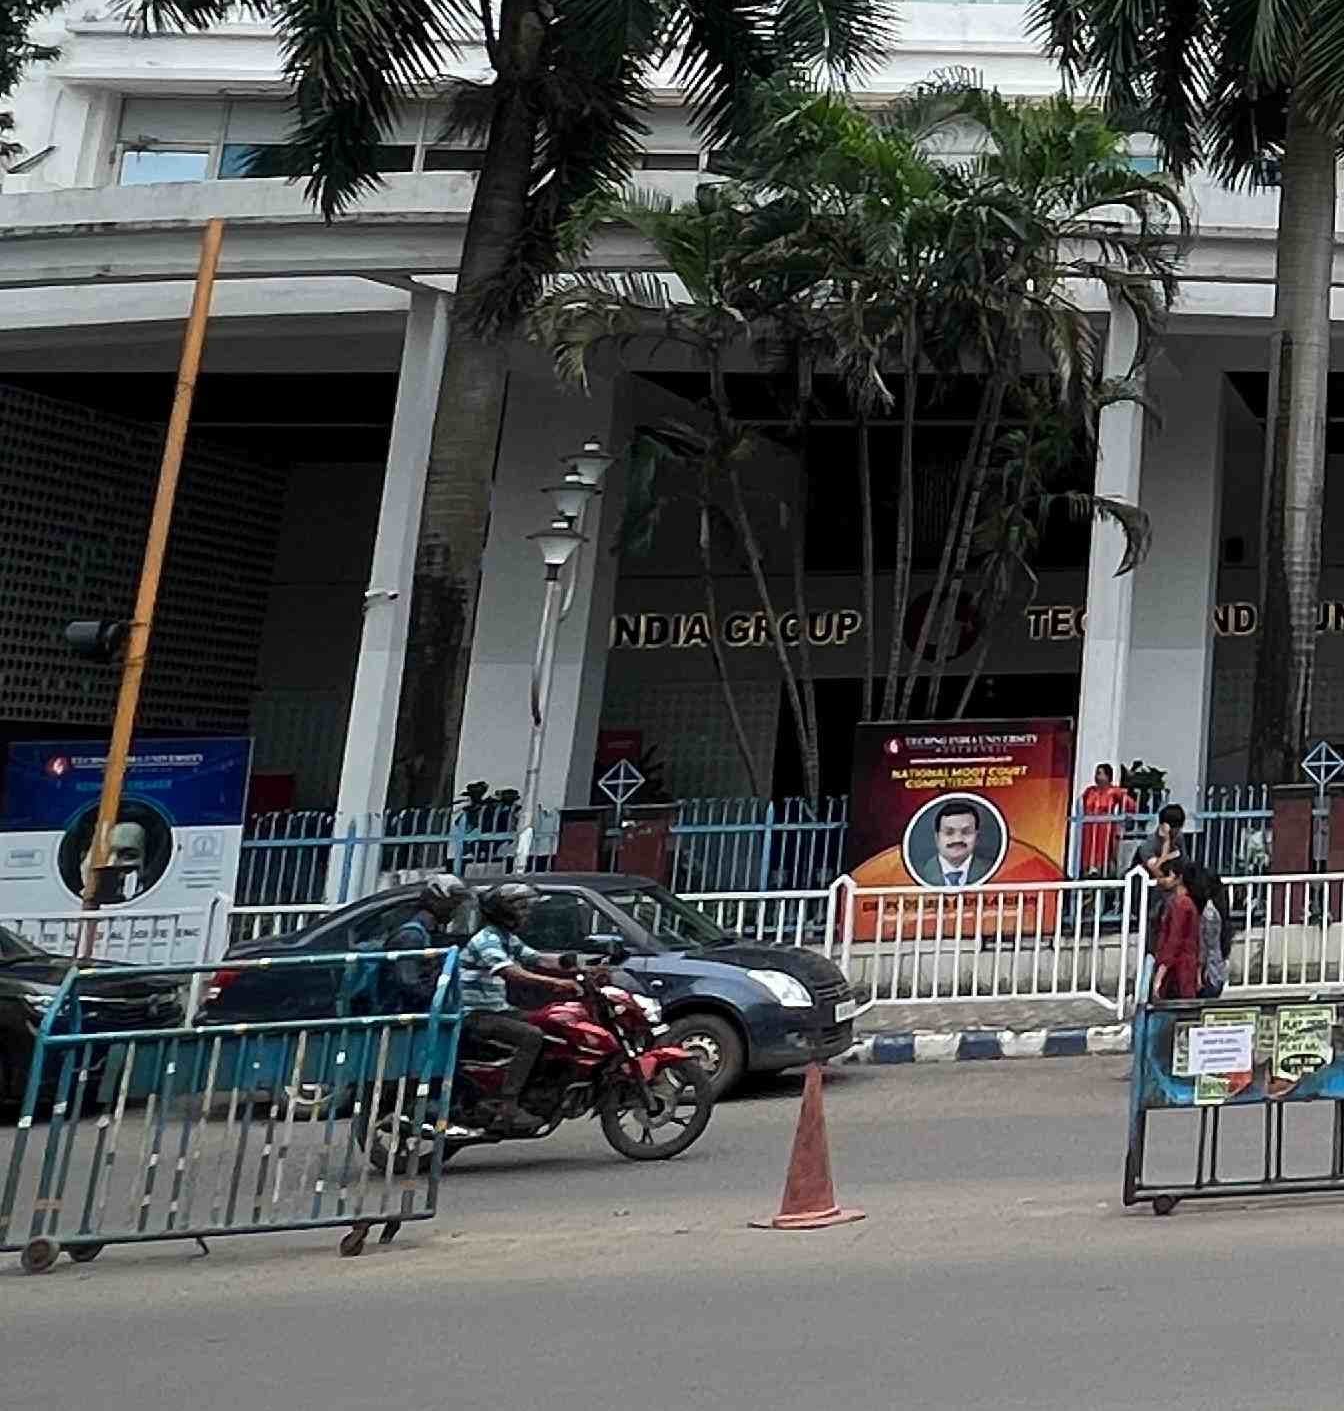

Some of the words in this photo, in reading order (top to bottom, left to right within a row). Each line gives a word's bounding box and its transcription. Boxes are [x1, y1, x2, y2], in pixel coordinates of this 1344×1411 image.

[610, 613, 712, 648] NDIA
[723, 610, 863, 647] GROUP
[891, 768, 949, 779] NATIONAL
[951, 766, 986, 777] MOOT
